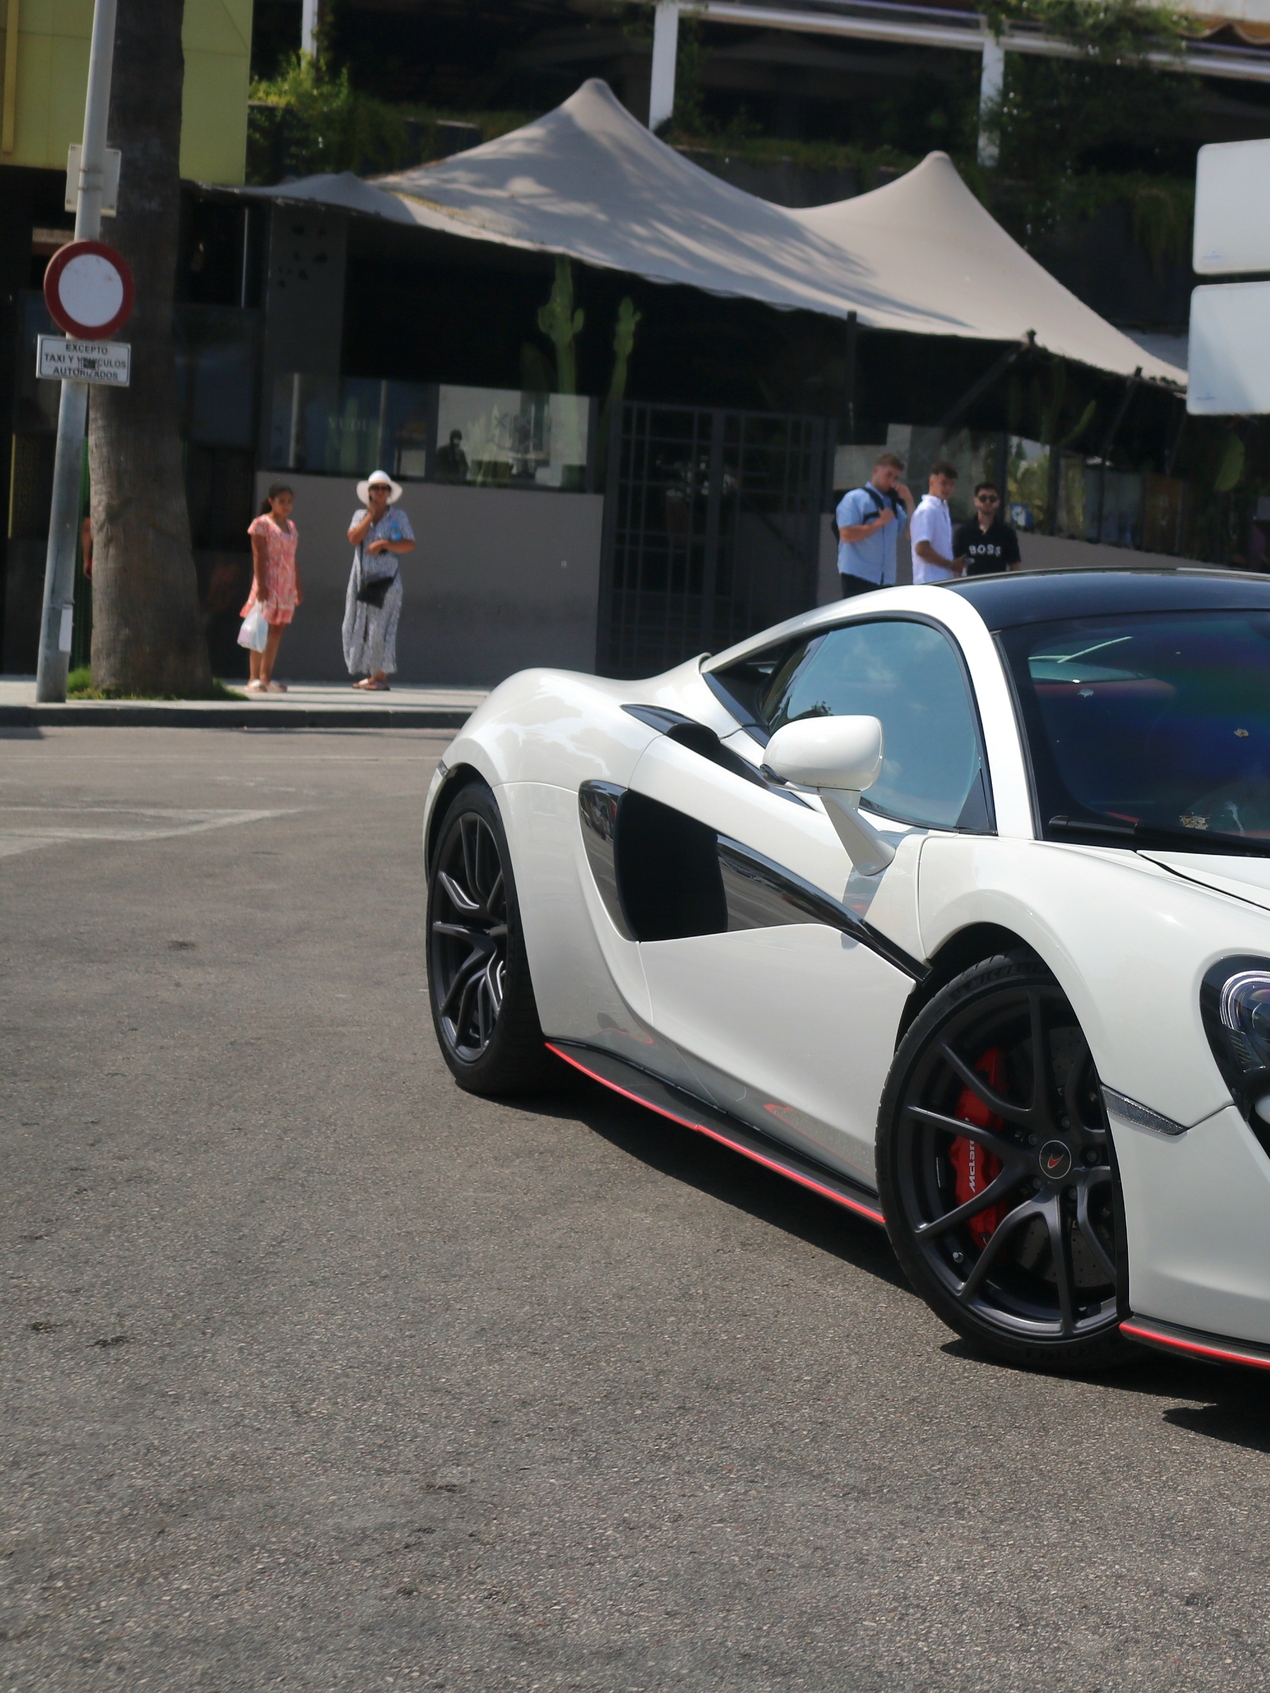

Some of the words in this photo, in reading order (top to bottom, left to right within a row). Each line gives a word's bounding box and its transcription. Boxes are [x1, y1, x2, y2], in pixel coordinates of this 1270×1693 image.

[66, 343, 108, 355] EXCEPTO
[44, 353, 66, 363] TAXI
[68, 355, 74, 364] Y
[77, 356, 126, 369] VCULOS
[53, 366, 118, 380] AUTORIZADOS
[968, 544, 1002, 557] BOSS
[968, 1139, 976, 1194] McLar
